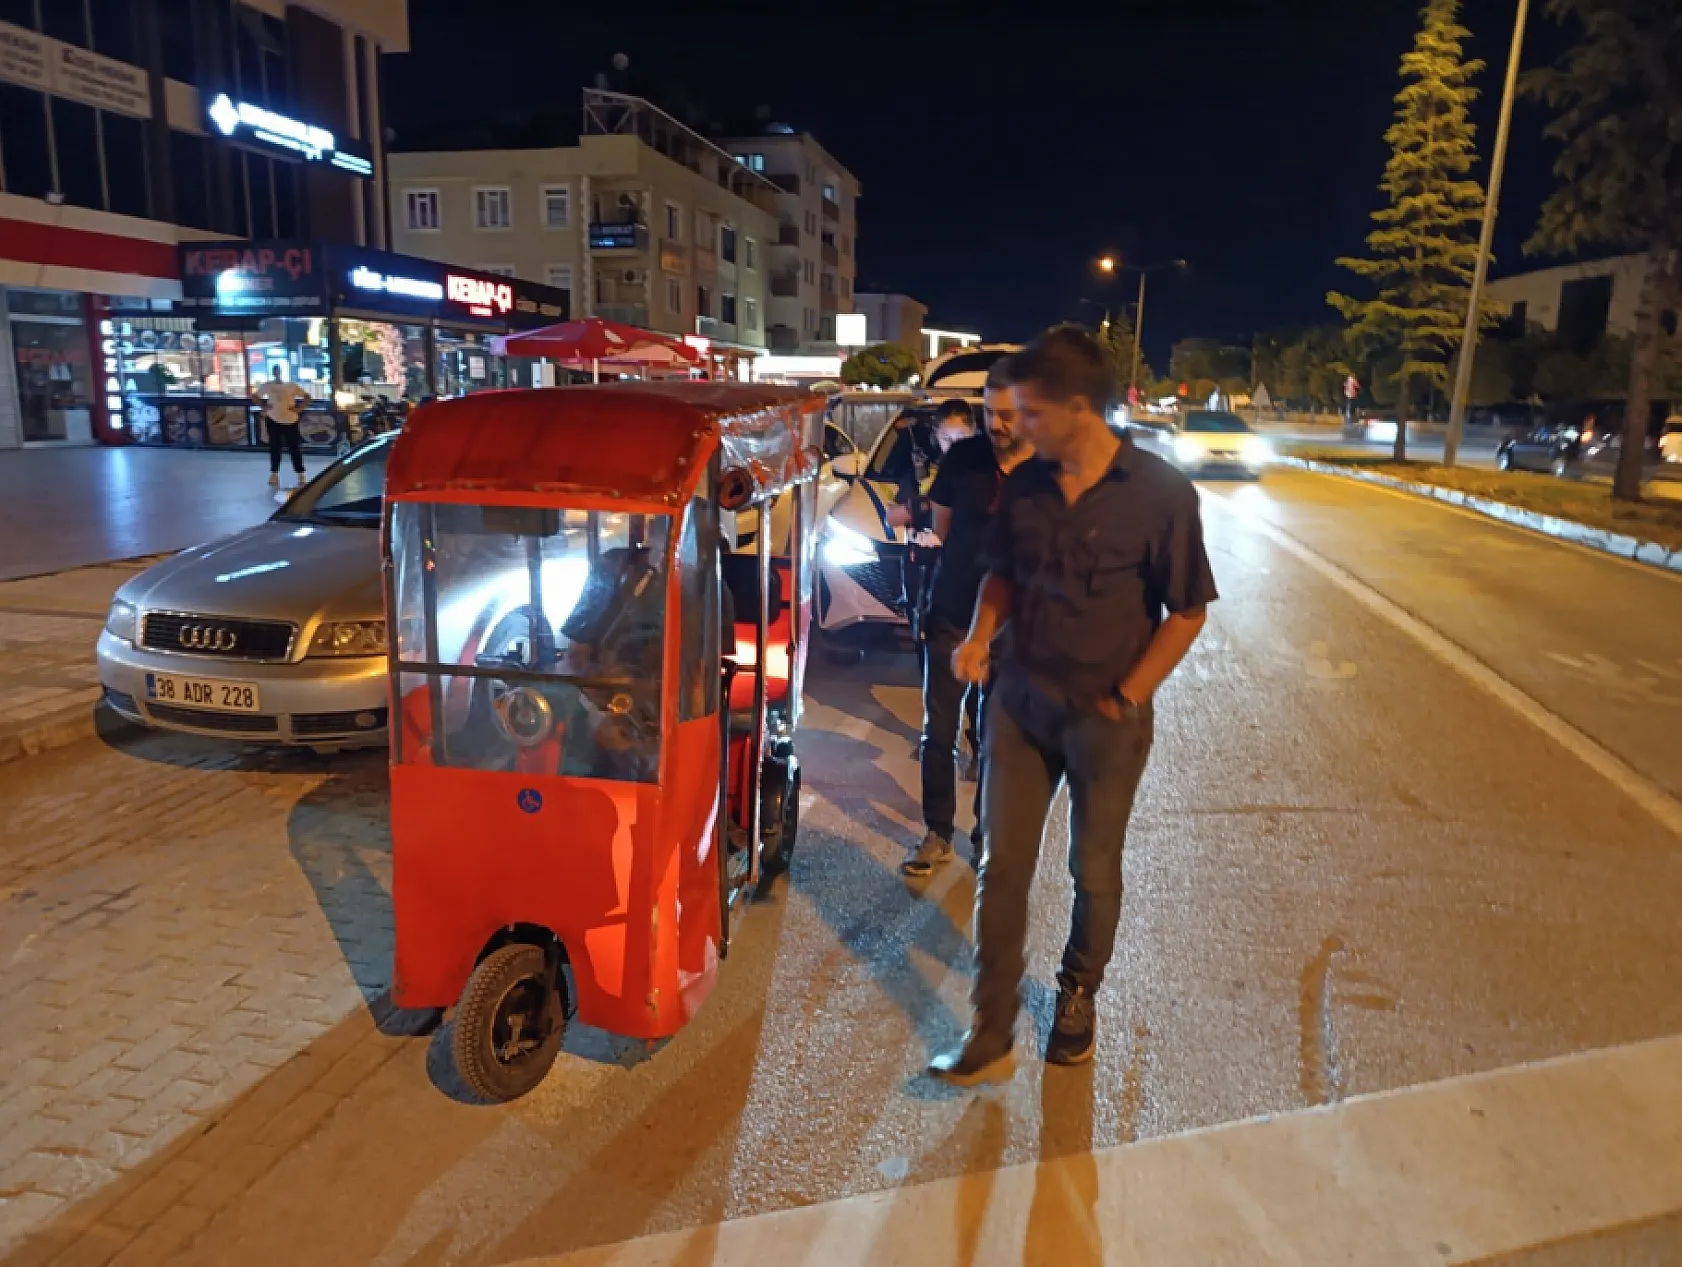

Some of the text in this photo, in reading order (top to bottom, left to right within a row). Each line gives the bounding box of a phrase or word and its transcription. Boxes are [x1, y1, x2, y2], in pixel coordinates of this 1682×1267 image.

[157, 677, 253, 708] 38 ADR 228
